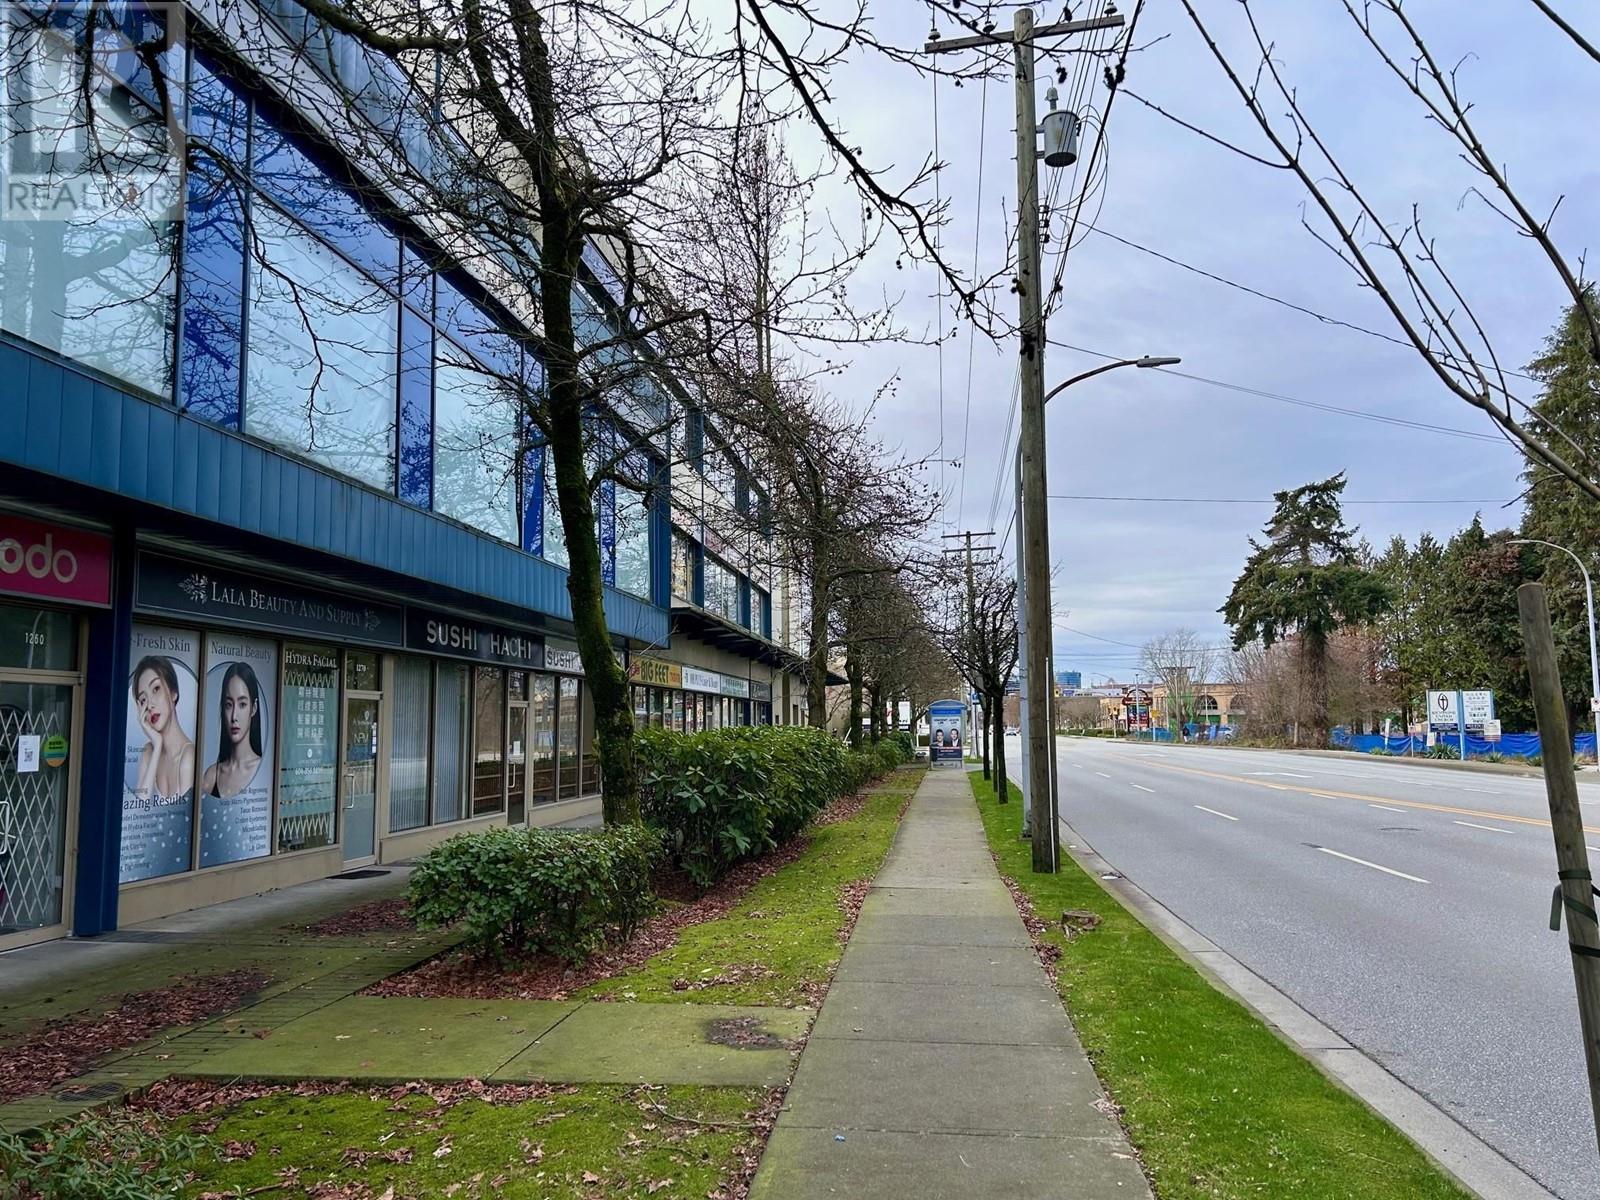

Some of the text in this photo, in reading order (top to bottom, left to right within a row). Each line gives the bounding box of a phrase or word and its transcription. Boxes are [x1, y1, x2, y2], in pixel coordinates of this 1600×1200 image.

[25, 632, 45, 646] 1260
[168, 636, 191, 652] Skin
[426, 619, 532, 660] SUSHI HACHI
[211, 640, 272, 663] Natural Beauty
[546, 650, 574, 669] SUSHI
[640, 659, 654, 682] BIG
[654, 662, 670, 684] FEET
[153, 793, 187, 807] Results
